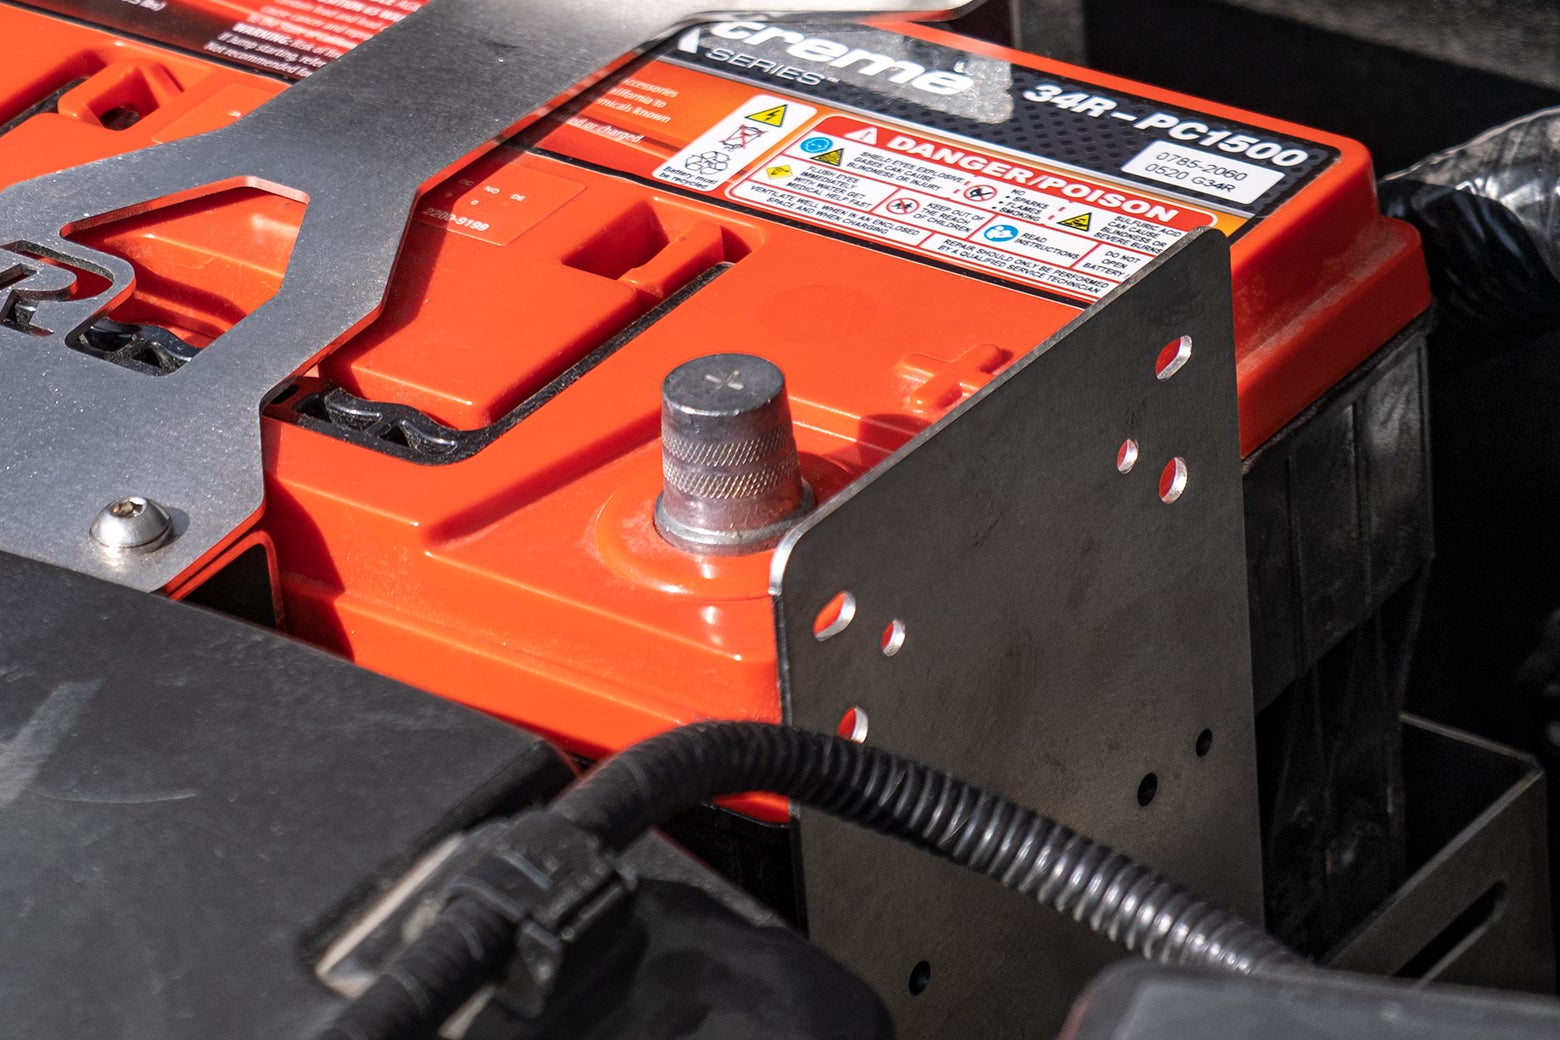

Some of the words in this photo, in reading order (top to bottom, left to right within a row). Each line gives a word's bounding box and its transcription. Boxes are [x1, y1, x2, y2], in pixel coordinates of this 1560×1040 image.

[806, 166, 836, 177] FLUSH
[834, 174, 860, 183] EYES
[883, 165, 905, 173] CAN
[904, 171, 935, 182] CAUSE
[891, 160, 916, 169] EYES
[914, 166, 965, 183] EXPLOSIVE
[1156, 151, 1248, 182] 0785-2060
[799, 171, 856, 189] IMMEDIATELY
[845, 162, 897, 179] BLINDNESS
[909, 179, 941, 191] INJURY
[886, 134, 1180, 223] DANGER/POISON
[1145, 162, 1188, 181] 0520
[1191, 175, 1236, 193] G34R
[785, 181, 825, 195] MEDICAL
[824, 192, 848, 202] HELP
[847, 199, 872, 208] FAST
[792, 176, 815, 185] WITH
[814, 182, 845, 194] WATER
[846, 191, 865, 199] GET
[748, 185, 796, 201] VENTILATE
[795, 198, 824, 209] WELL
[822, 205, 849, 216] WHEN
[871, 219, 920, 235] ENCLOSED
[925, 202, 950, 212] KEEP
[950, 209, 972, 218] OUT
[1004, 201, 1043, 215] FLAMES
[1012, 196, 1050, 209] SPARKS
[918, 207, 938, 216] THE
[937, 213, 971, 225] REACH
[998, 207, 1041, 222] SMOKING
[841, 218, 890, 234] CHARGING
[924, 216, 973, 233] CHILDREN
[1106, 220, 1133, 231] CAN
[1131, 227, 1161, 239] CAUSE
[1113, 215, 1161, 231] SULFURIC
[1158, 228, 1182, 237] ACID
[1020, 232, 1048, 243] READ
[1092, 231, 1131, 245] SEVERE
[1128, 242, 1163, 254] BURNS
[1099, 226, 1153, 244] BLINDNESS
[1150, 240, 1168, 248] OR
[1013, 238, 1080, 259] INSTRUCTIONS
[1104, 250, 1121, 258] DO
[1118, 255, 1141, 264] NOT
[942, 239, 977, 251] REPAIR
[975, 248, 1015, 262] SHOULD
[1013, 258, 1040, 269] ONLY
[1050, 269, 1110, 288] PERFORMED
[957, 250, 1007, 267] QUALIFIED
[1004, 263, 1047, 278] SERVICE
[1044, 274, 1102, 293] TECHNICIAN
[1082, 262, 1125, 277] BATTERY
[1099, 258, 1128, 269] OPEN
